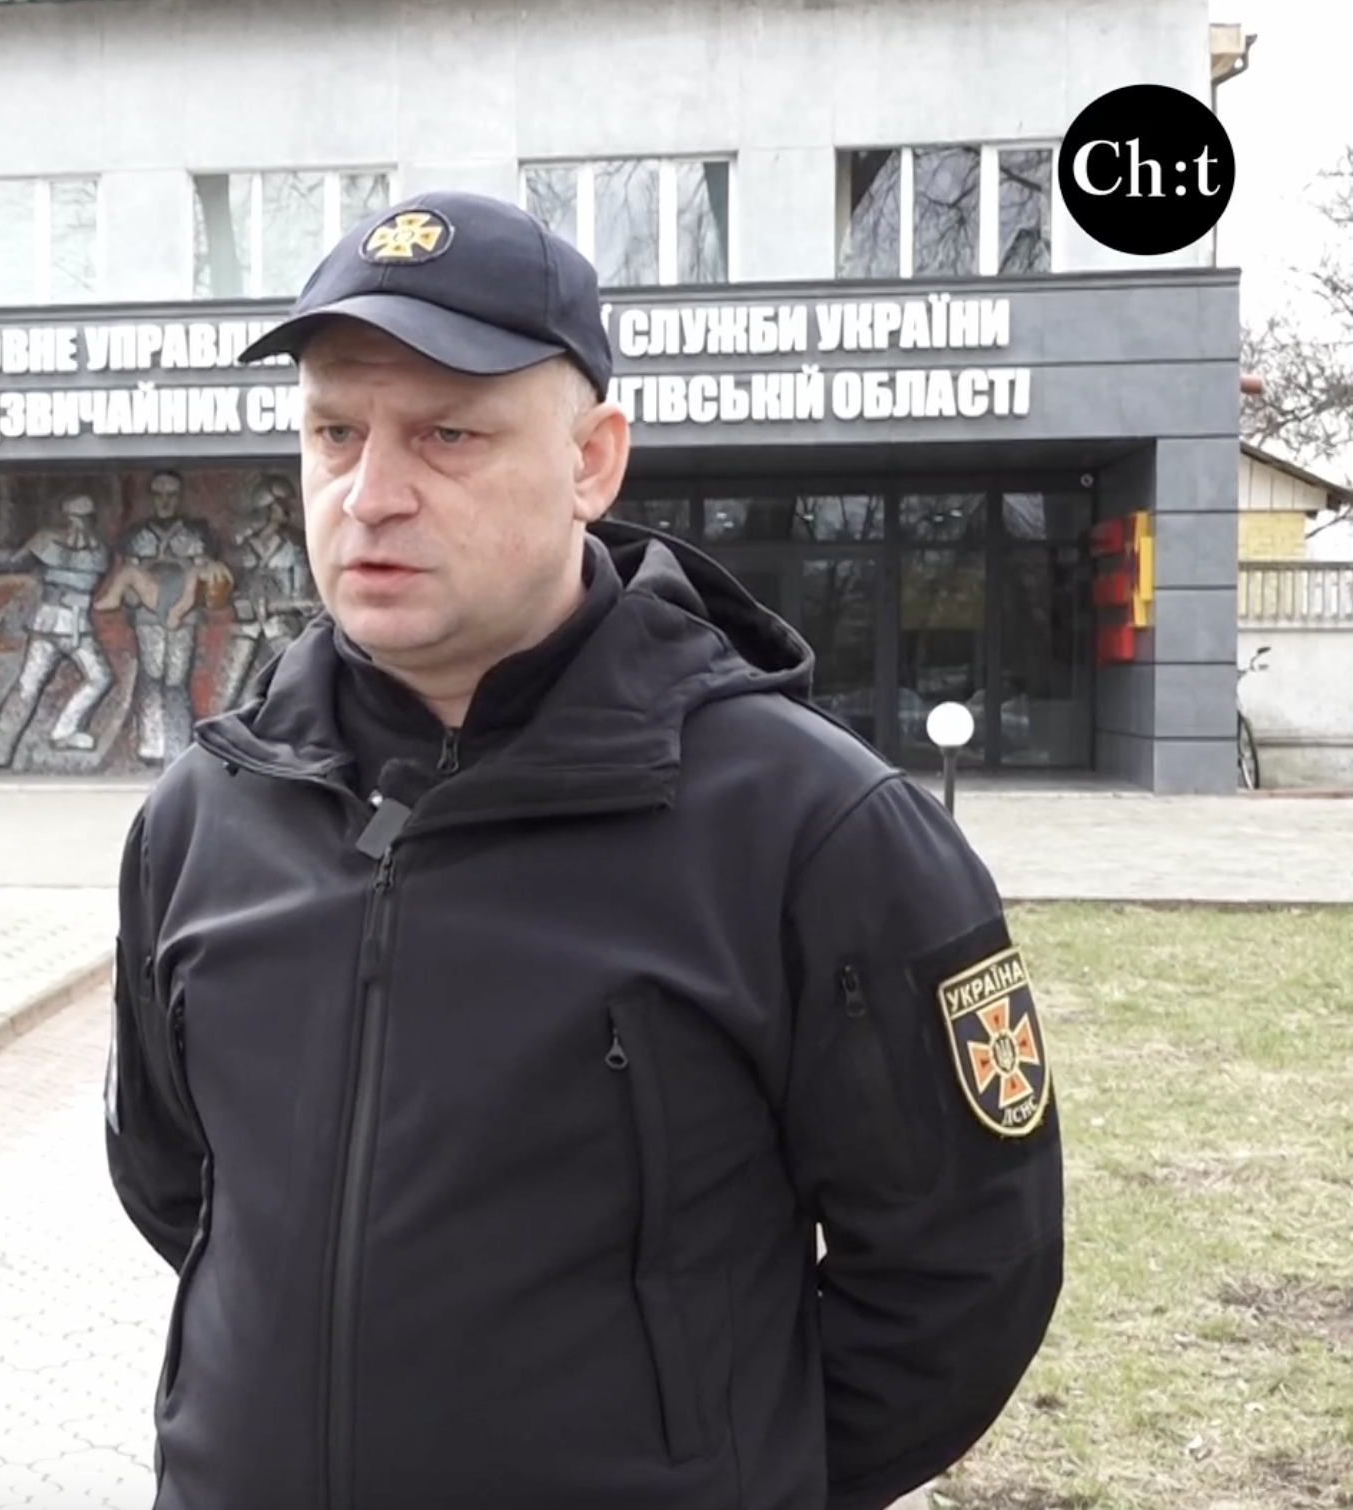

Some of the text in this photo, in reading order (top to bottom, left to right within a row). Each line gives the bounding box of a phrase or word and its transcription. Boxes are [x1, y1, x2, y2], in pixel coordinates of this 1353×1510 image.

[618, 304, 808, 357] СЛУЖБИ
[815, 293, 1010, 351] УКРАЇНИ
[832, 368, 1032, 420] ОБЛАСТІ
[947, 959, 1025, 1013] УКРАЇНА
